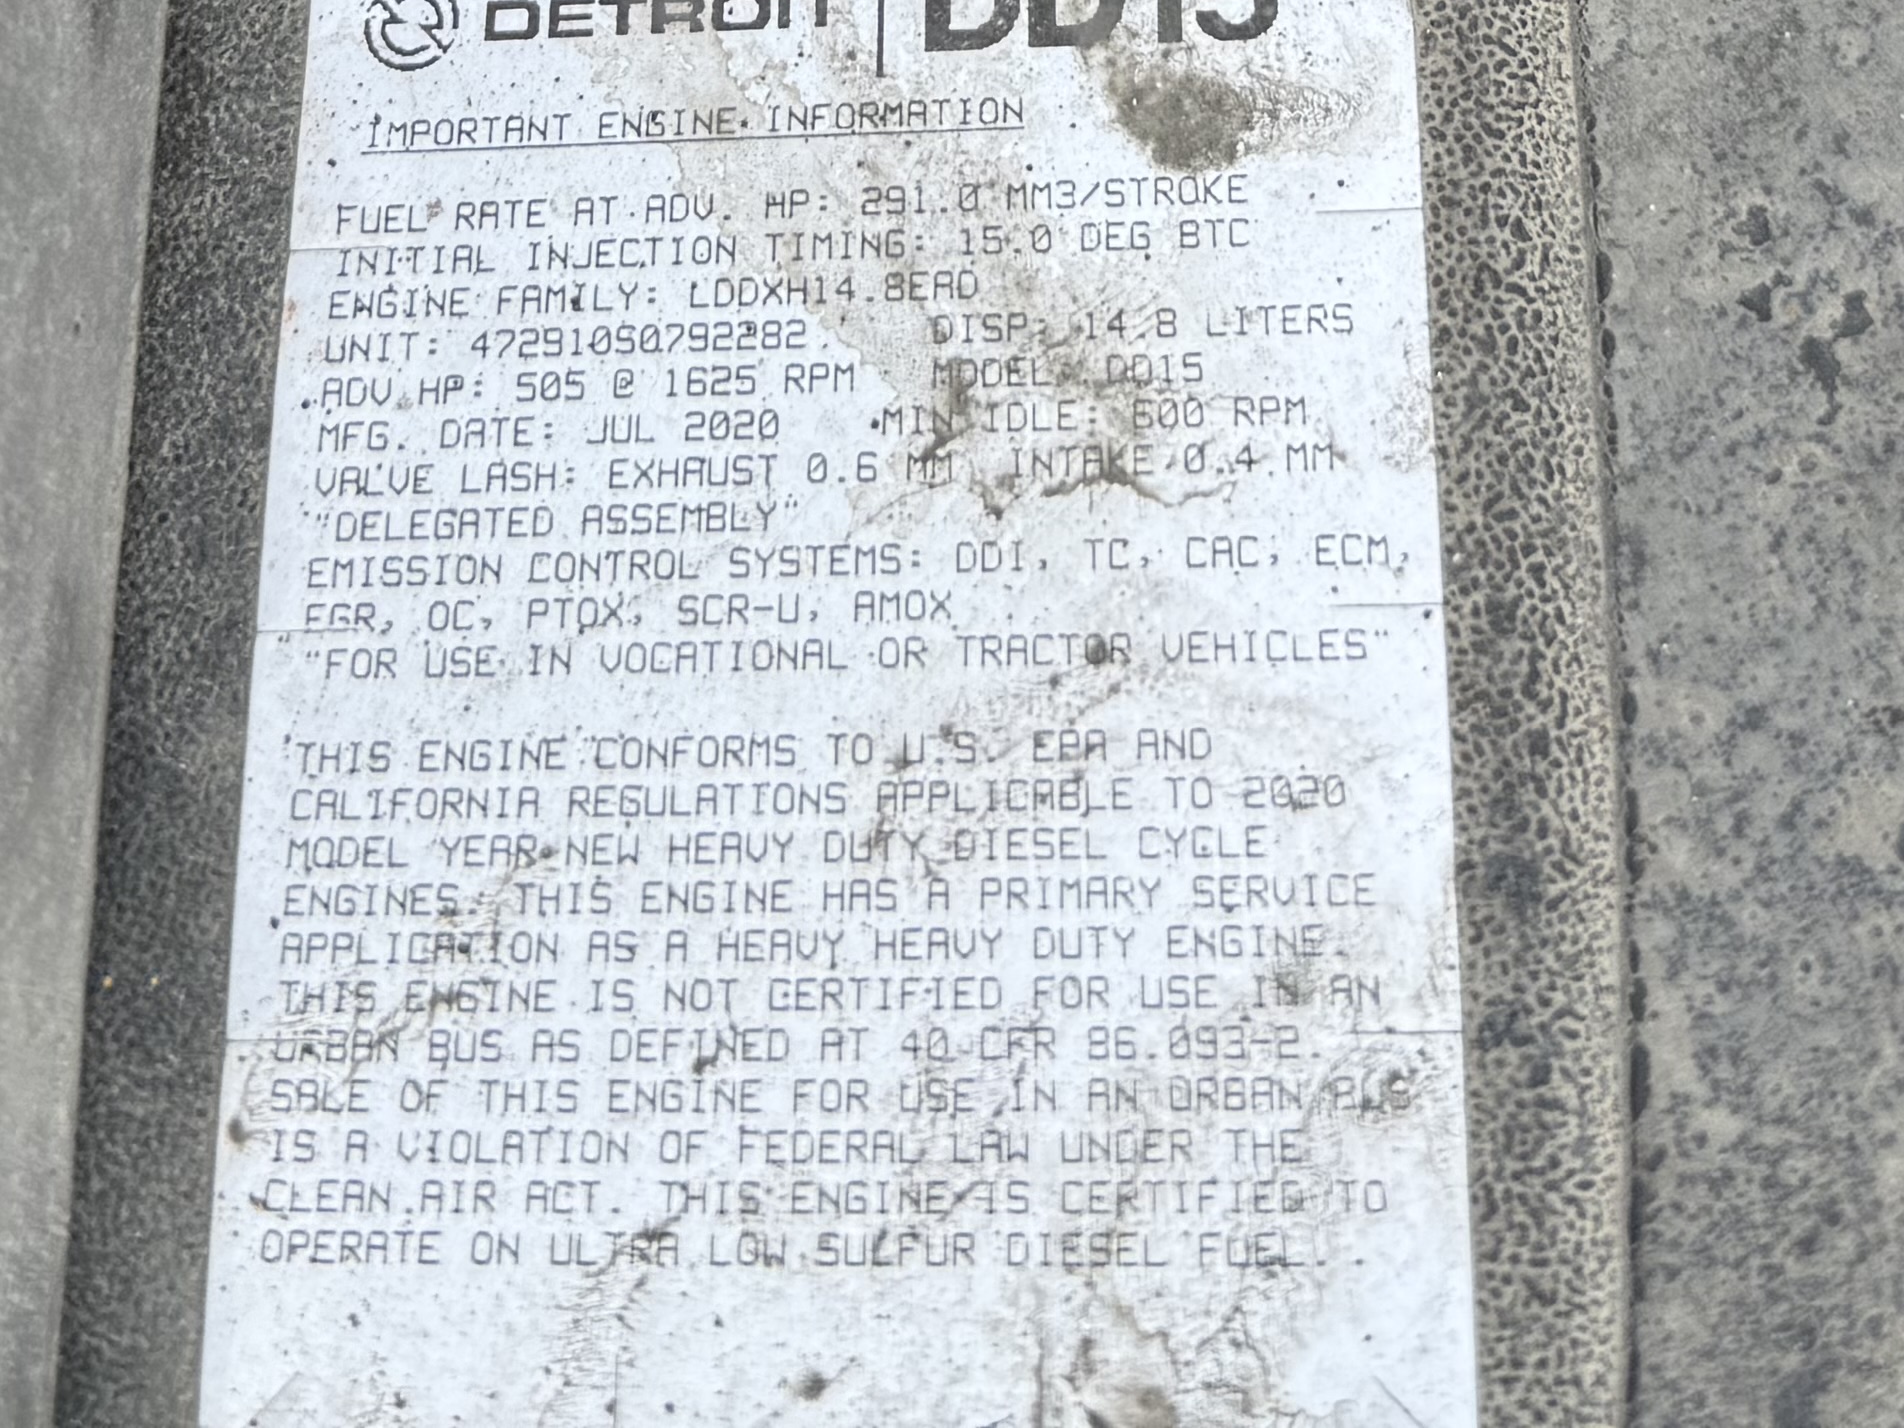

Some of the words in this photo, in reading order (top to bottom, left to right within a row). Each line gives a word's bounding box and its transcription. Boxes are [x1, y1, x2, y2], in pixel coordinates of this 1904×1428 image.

[370, 112, 572, 148] IMPORTANT
[598, 106, 738, 140] ENGINE
[768, 96, 1025, 134] INFORMATION
[334, 201, 428, 236] FUEL
[453, 197, 549, 232] RATE
[572, 194, 619, 228] AT
[763, 187, 830, 221] HP:
[860, 182, 982, 218] 291.0
[1009, 173, 1249, 213] MM3/STROKE
[337, 243, 500, 278] INITIAL
[527, 235, 747, 272] INJECTION
[769, 229, 924, 265] TIMING:
[960, 225, 1053, 259] 15.0
[1078, 221, 1151, 255] DEG
[1177, 218, 1250, 252] BTC
[326, 286, 471, 321] ENGINE
[495, 280, 657, 316] FAMILY:
[1083, 308, 1178, 342] 14.8
[1204, 304, 1354, 339] LITERS
[322, 330, 438, 364] UNIT:
[320, 375, 393, 409] ADV
[416, 373, 483, 406] HP:
[514, 370, 586, 404] 505
[611, 369, 635, 401] @
[665, 366, 757, 399] 1625
[782, 363, 855, 396] RPM
[316, 420, 405, 453] MFG.
[438, 415, 554, 450] DATE:
[583, 413, 655, 446] JUL
[683, 409, 780, 443] 2020
[879, 403, 956, 437] MIN
[982, 401, 1097, 435] IDLE:
[1130, 399, 1207, 432] 600
[1232, 397, 1307, 430] RPM
[313, 463, 435, 497] VALVE
[459, 460, 575, 494] LASH:
[606, 456, 780, 491] EXHAUST
[805, 454, 878, 487] 0.6
[1011, 445, 1154, 479] INTAKE
[1284, 442, 1336, 475] MM
[306, 553, 503, 588] EMISSION
[527, 549, 702, 584] CONTROL
[727, 544, 921, 580] SYSTEMS:
[954, 542, 1048, 578] DDI,
[1083, 539, 1150, 576] TC,
[1184, 537, 1279, 574] CAC,
[426, 598, 493, 635] OC,
[675, 592, 819, 629] SCR-U,
[852, 589, 952, 624] AMOX
[423, 645, 506, 678] USE
[527, 644, 572, 676] IN
[598, 639, 849, 675] VOCATIONAL
[877, 638, 929, 670] OR
[954, 634, 1132, 668] TRACTOR
[295, 741, 392, 774] THIS
[417, 739, 566, 772] ENGINE
[591, 735, 797, 769] CONFORMS
[826, 734, 874, 766] TO
[1031, 730, 1108, 763] EPA
[1135, 728, 1212, 761] AND
[288, 786, 540, 822] CALIFORNIA
[566, 782, 847, 819] REGULATIONS
[874, 779, 1133, 815] APPLICABLE
[1164, 778, 1214, 811] TO
[1240, 776, 1347, 810] 2020
[285, 835, 409, 869] MODEL
[440, 833, 540, 868] YEAR
[564, 832, 640, 866] NEW
[666, 831, 795, 865] HEAVY
[822, 829, 928, 864] DUTY
[956, 828, 1109, 862] DIESEL
[1137, 826, 1266, 860] CYCLE
[513, 881, 613, 914] THIS
[639, 879, 793, 913] ENGINE
[821, 878, 898, 912] HAS
[978, 875, 1162, 910] PRIMARY
[1191, 873, 1375, 909] SERVICE
[278, 930, 559, 966] APPLICATION
[585, 929, 638, 964] AS
[715, 928, 845, 963] HEAVY
[872, 927, 1003, 962] HEAVY
[1032, 926, 1136, 960] DUTY
[279, 980, 377, 1014] THIS
[402, 979, 557, 1013] ENGINE
[590, 978, 635, 1013] IS
[662, 978, 738, 1012] NOT
[766, 977, 1003, 1012] CERTIFIED
[1031, 976, 1110, 1011] FOR
[1139, 976, 1217, 1010] USE
[1332, 975, 1381, 1009] AN
[427, 1030, 504, 1063] BUS
[530, 1030, 581, 1062] AS
[608, 1029, 790, 1062] DEFINED
[819, 1029, 870, 1061] AT
[899, 1028, 949, 1061] 40
[269, 1079, 371, 1113] SALE
[398, 1079, 448, 1113] OF
[477, 1079, 579, 1113] THIS
[606, 1079, 763, 1113] ENGINE
[791, 1078, 870, 1113] FOR
[1086, 1078, 1138, 1113] AN
[1167, 1078, 1304, 1113] URBAN
[269, 1130, 317, 1164] IS
[395, 1130, 630, 1164] VIOLATION
[737, 1129, 922, 1164] FEDERAL
[264, 1179, 392, 1214] CLEAN
[418, 1179, 497, 1214] AIR
[524, 1179, 620, 1214] ACT.
[658, 1180, 768, 1214] THIS
[796, 1180, 952, 1215] ENGINE
[1340, 1181, 1388, 1215] TO
[258, 1231, 441, 1266] OPERATE
[469, 1231, 521, 1266] ON
